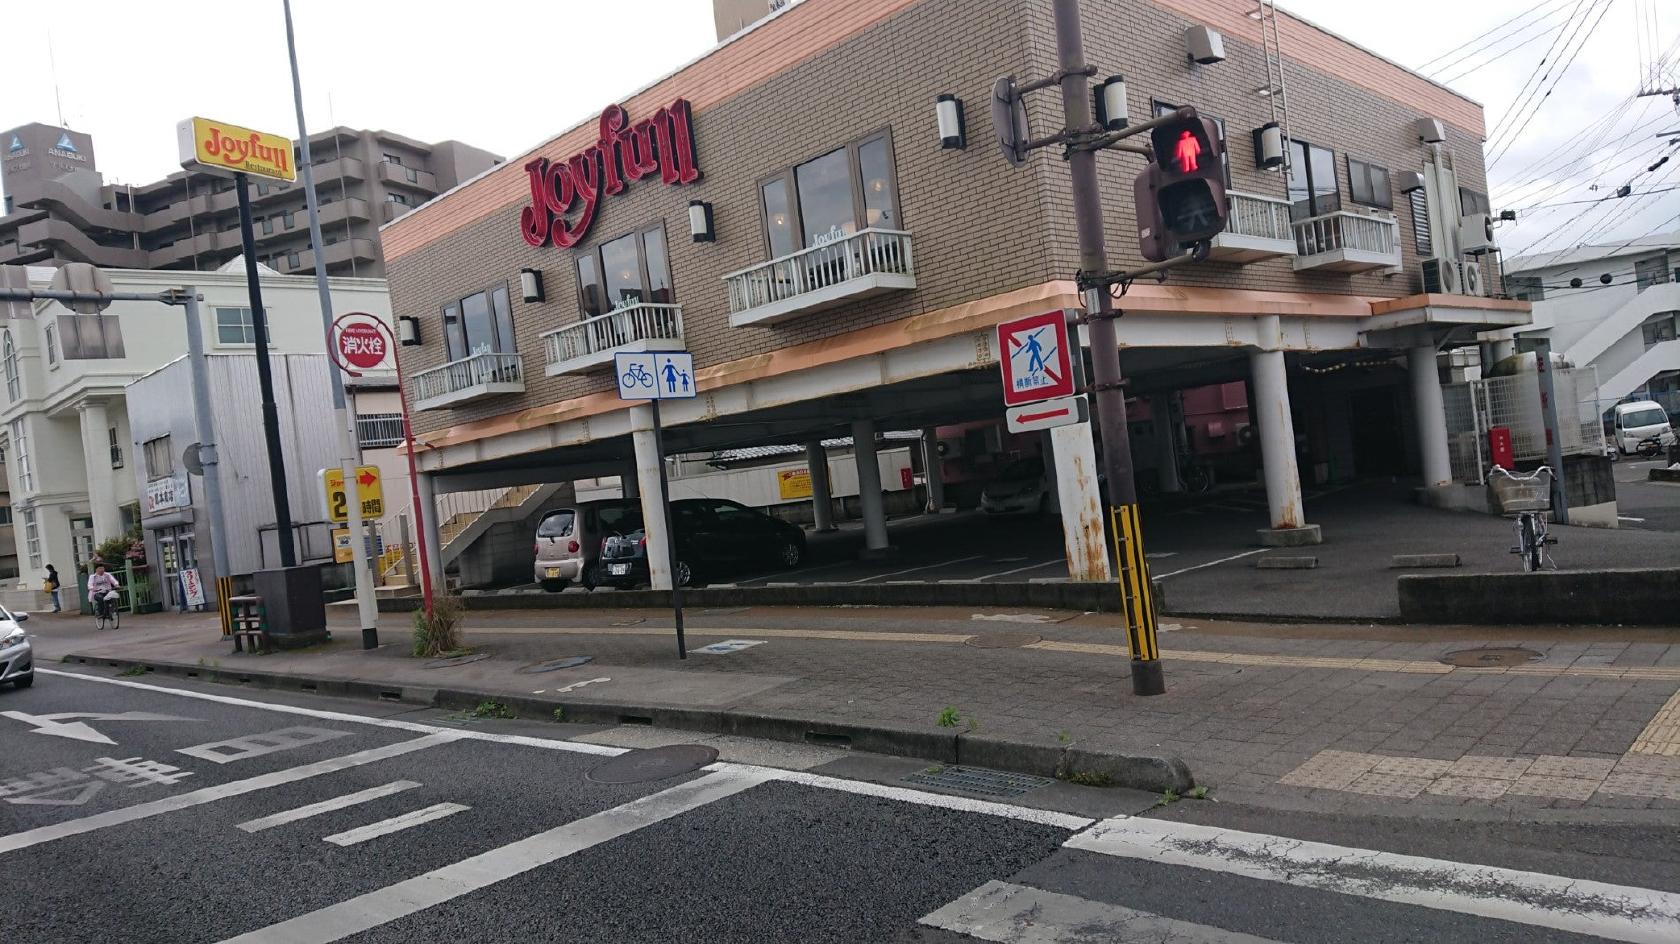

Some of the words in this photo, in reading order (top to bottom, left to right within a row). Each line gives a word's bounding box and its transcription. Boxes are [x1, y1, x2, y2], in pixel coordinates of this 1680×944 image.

[204, 127, 289, 172] Joyfull
[520, 98, 704, 248] Joyfull
[342, 336, 384, 354] 消火栓
[1016, 375, 1049, 390] 横断禁止
